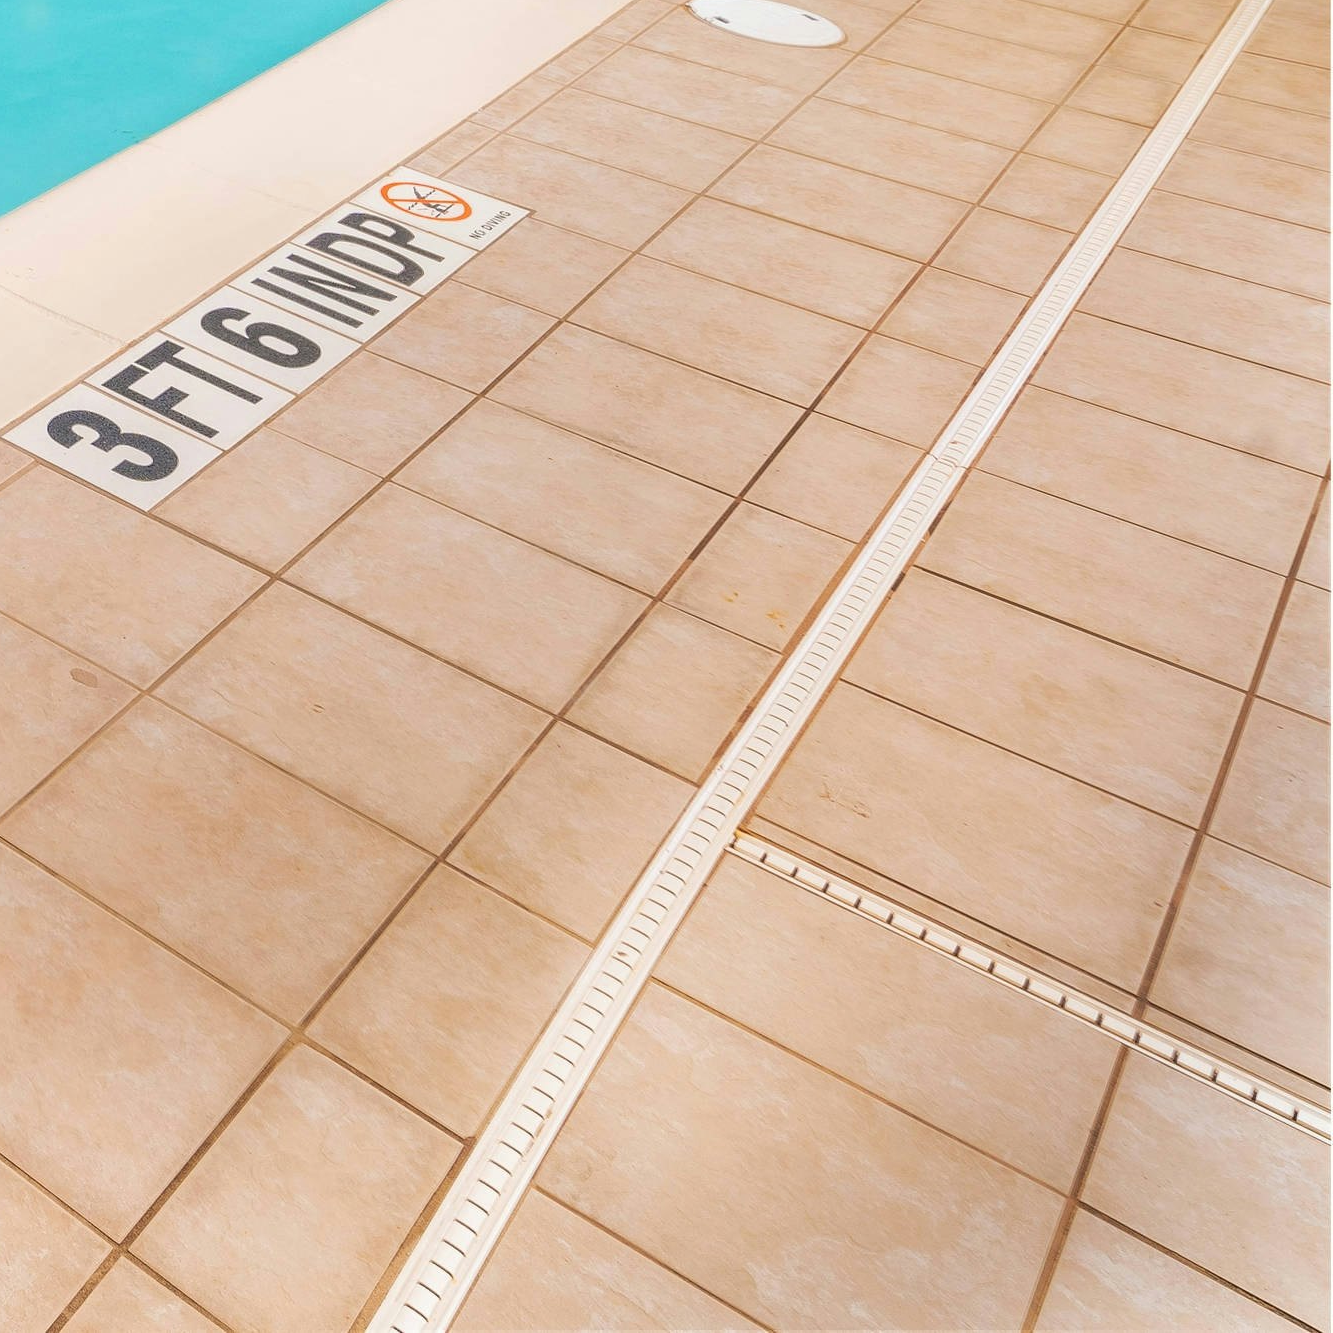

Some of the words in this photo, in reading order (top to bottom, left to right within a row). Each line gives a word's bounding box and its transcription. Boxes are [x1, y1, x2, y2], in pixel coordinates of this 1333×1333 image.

[468, 229, 486, 240] NO
[481, 210, 512, 231] DIVING
[200, 306, 322, 369] 6
[101, 339, 264, 439] FT
[46, 408, 180, 482] 3
